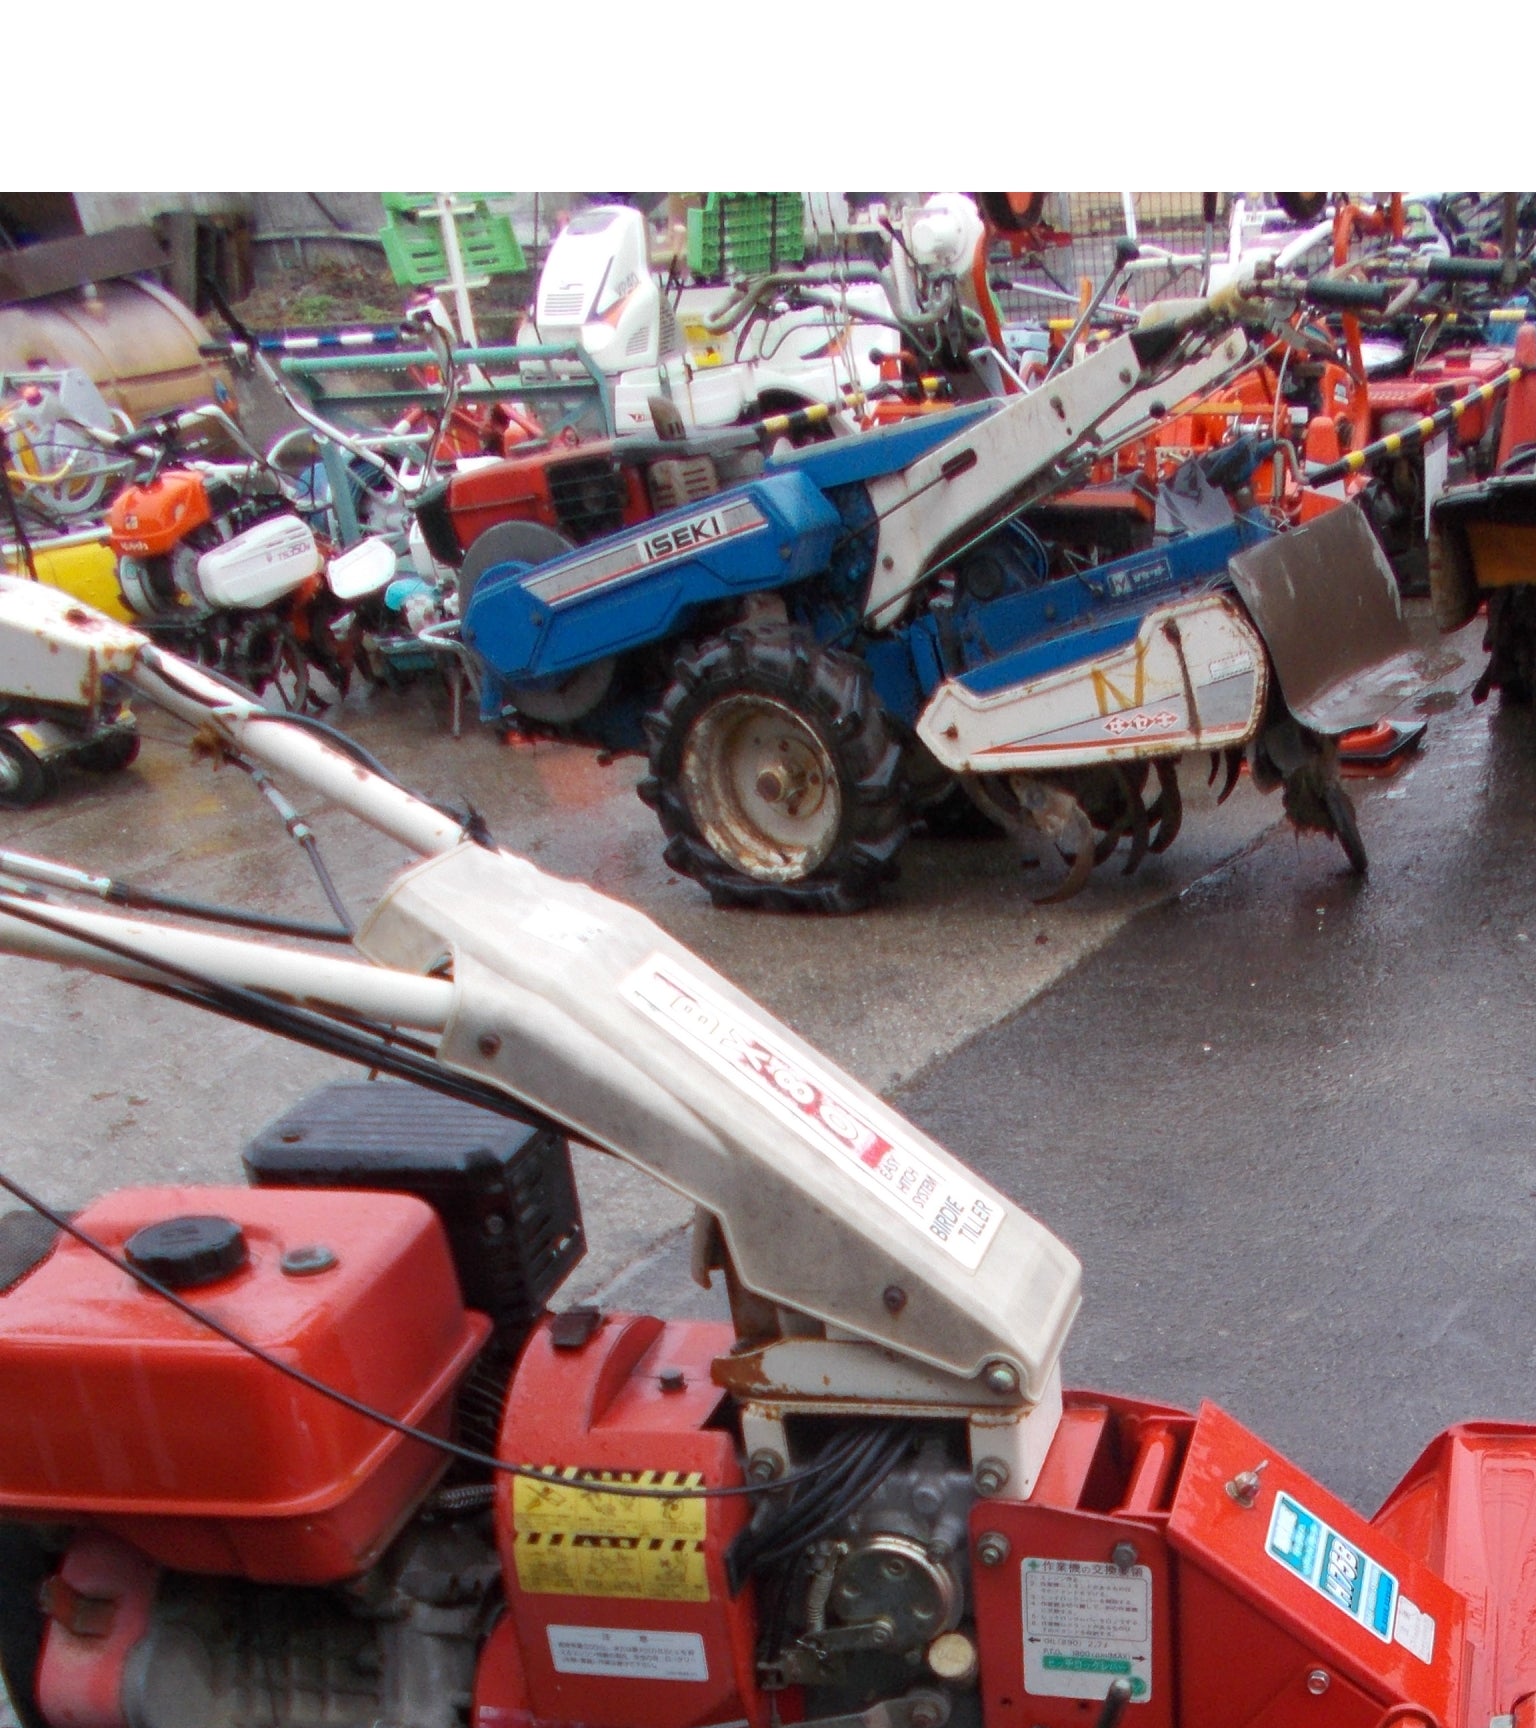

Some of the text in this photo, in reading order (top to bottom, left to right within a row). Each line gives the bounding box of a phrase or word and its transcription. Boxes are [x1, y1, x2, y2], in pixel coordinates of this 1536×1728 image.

[643, 516, 721, 560] ISEKI
[879, 1156, 901, 1183] EASY
[897, 1166, 920, 1195] HITCH
[912, 1177, 938, 1210] SYSTEM
[928, 1195, 966, 1243] BIRDIE
[957, 1198, 994, 1246] TILLER
